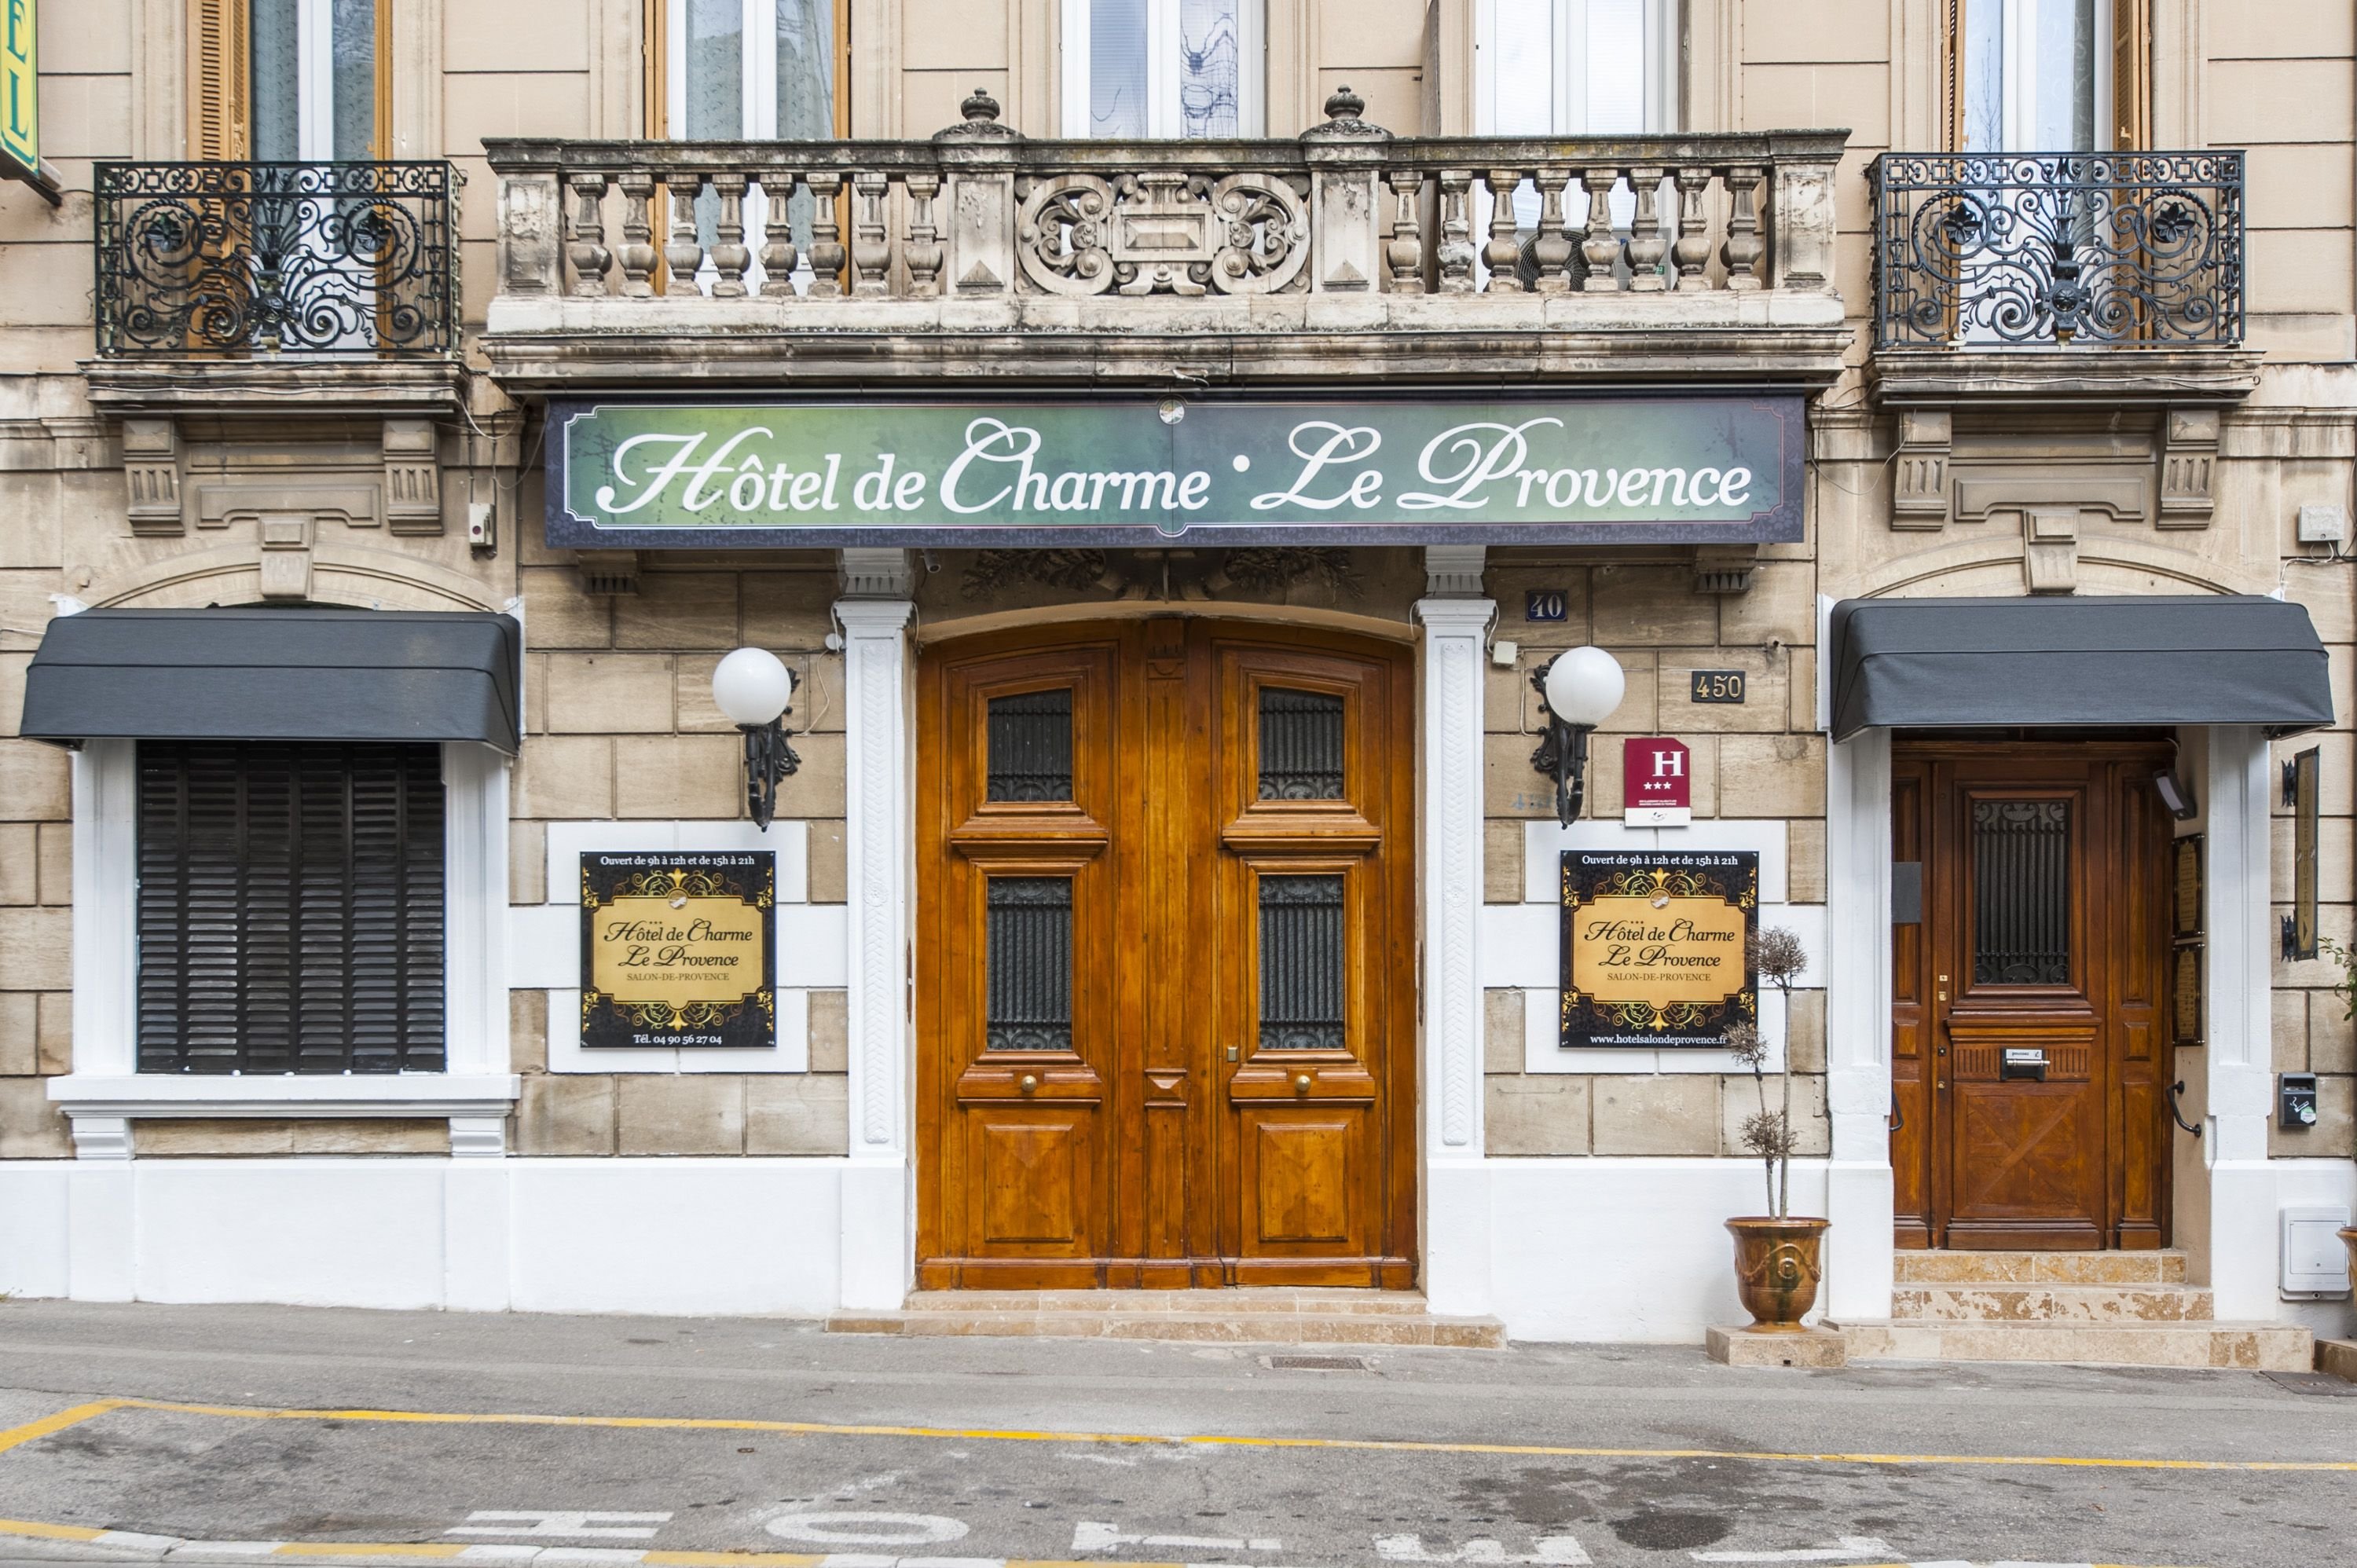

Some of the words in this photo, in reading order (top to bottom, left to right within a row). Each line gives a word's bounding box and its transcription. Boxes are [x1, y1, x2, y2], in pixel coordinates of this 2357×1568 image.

[595, 427, 839, 513] Hôtel
[853, 453, 925, 512] de
[941, 416, 1211, 514] Charme
[1250, 420, 1384, 511] Le
[1396, 417, 1751, 510] Provence
[1530, 595, 1563, 617] 40
[1696, 676, 1743, 698] 450
[1651, 750, 1684, 777] H
[600, 855, 633, 865] Ouvert
[634, 855, 646, 865] de
[647, 855, 661, 866] 9h
[662, 855, 668, 865] à
[670, 855, 686, 865] 12h
[687, 856, 697, 865] et
[699, 855, 710, 865] de
[713, 855, 728, 866] 15h
[730, 855, 736, 865] à
[739, 855, 755, 865] 21h
[1582, 855, 1615, 865] Ouvert
[1616, 855, 1628, 865] de
[1630, 855, 1642, 866] 9h
[1644, 855, 1650, 865] à
[1652, 855, 1669, 865] 12h
[1670, 855, 1680, 865] et
[1681, 855, 1693, 865] de
[1695, 855, 1711, 866] 15h
[1714, 855, 1719, 865] à
[1721, 855, 1738, 866] 21h
[603, 920, 663, 942] Hôtel
[666, 927, 684, 941] de
[687, 918, 753, 942] Charme
[1584, 920, 1644, 941] Hôtel
[1648, 927, 1666, 941] de
[1668, 918, 1735, 942] Charme
[618, 944, 650, 967] Le
[653, 943, 739, 967] Provence
[1598, 944, 1631, 967] Le
[1633, 943, 1721, 967] Provence
[627, 973, 729, 981] SALON-DE-PROVENCE
[1607, 973, 1711, 981] SALON-DE-PROVENCE
[633, 1034, 651, 1044] Tél.
[653, 1035, 666, 1045] 04
[668, 1035, 680, 1045] 90
[682, 1034, 695, 1045] 56
[696, 1035, 708, 1045] 27
[709, 1035, 722, 1045] 04
[1590, 1034, 1728, 1046] www.hotelsalondeprovence.fr
